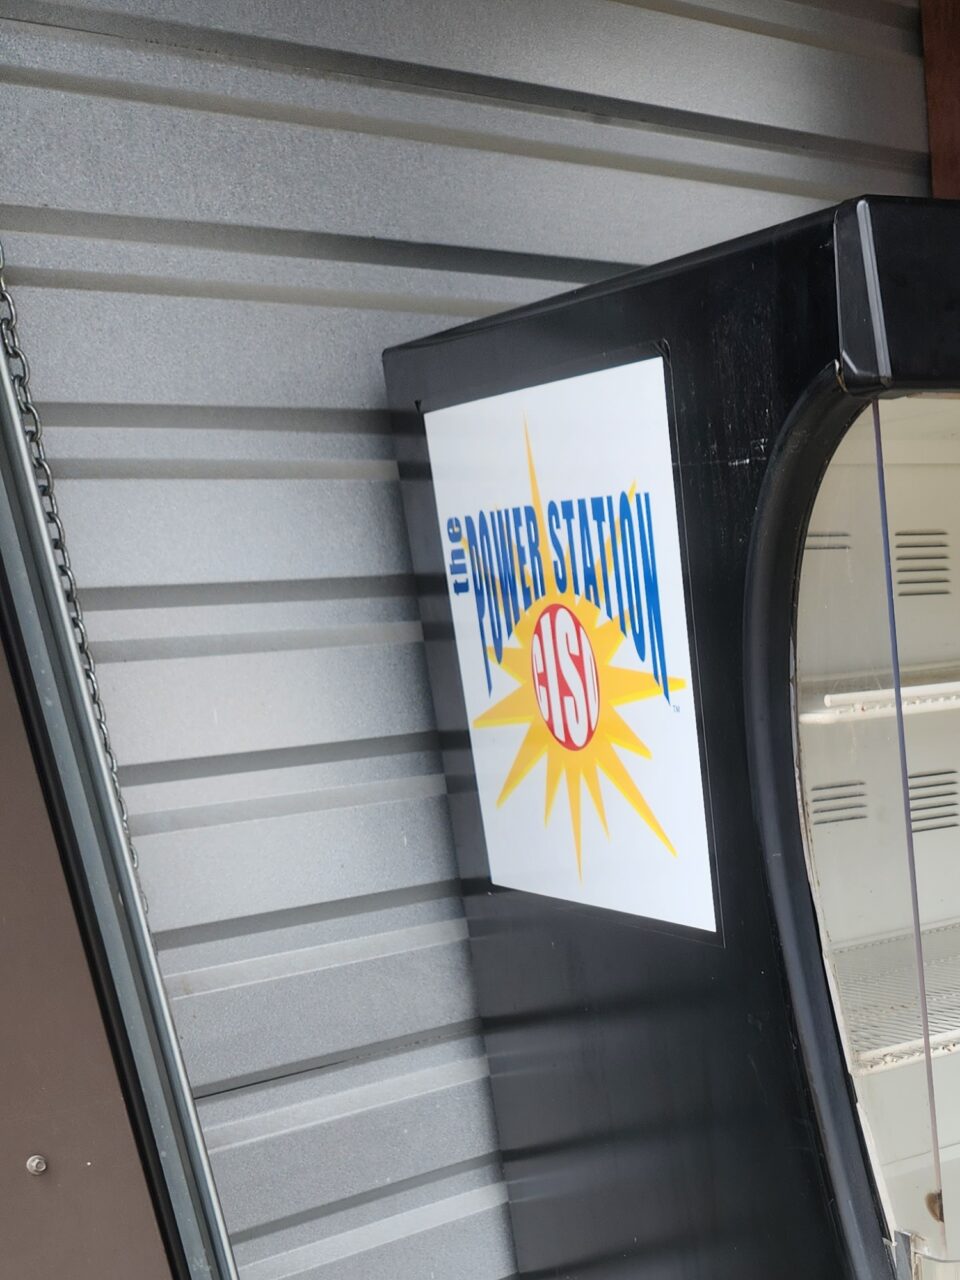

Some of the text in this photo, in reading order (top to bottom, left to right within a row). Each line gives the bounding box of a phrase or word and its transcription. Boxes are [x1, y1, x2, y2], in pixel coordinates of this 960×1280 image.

[447, 490, 670, 705] the POWER STATION
